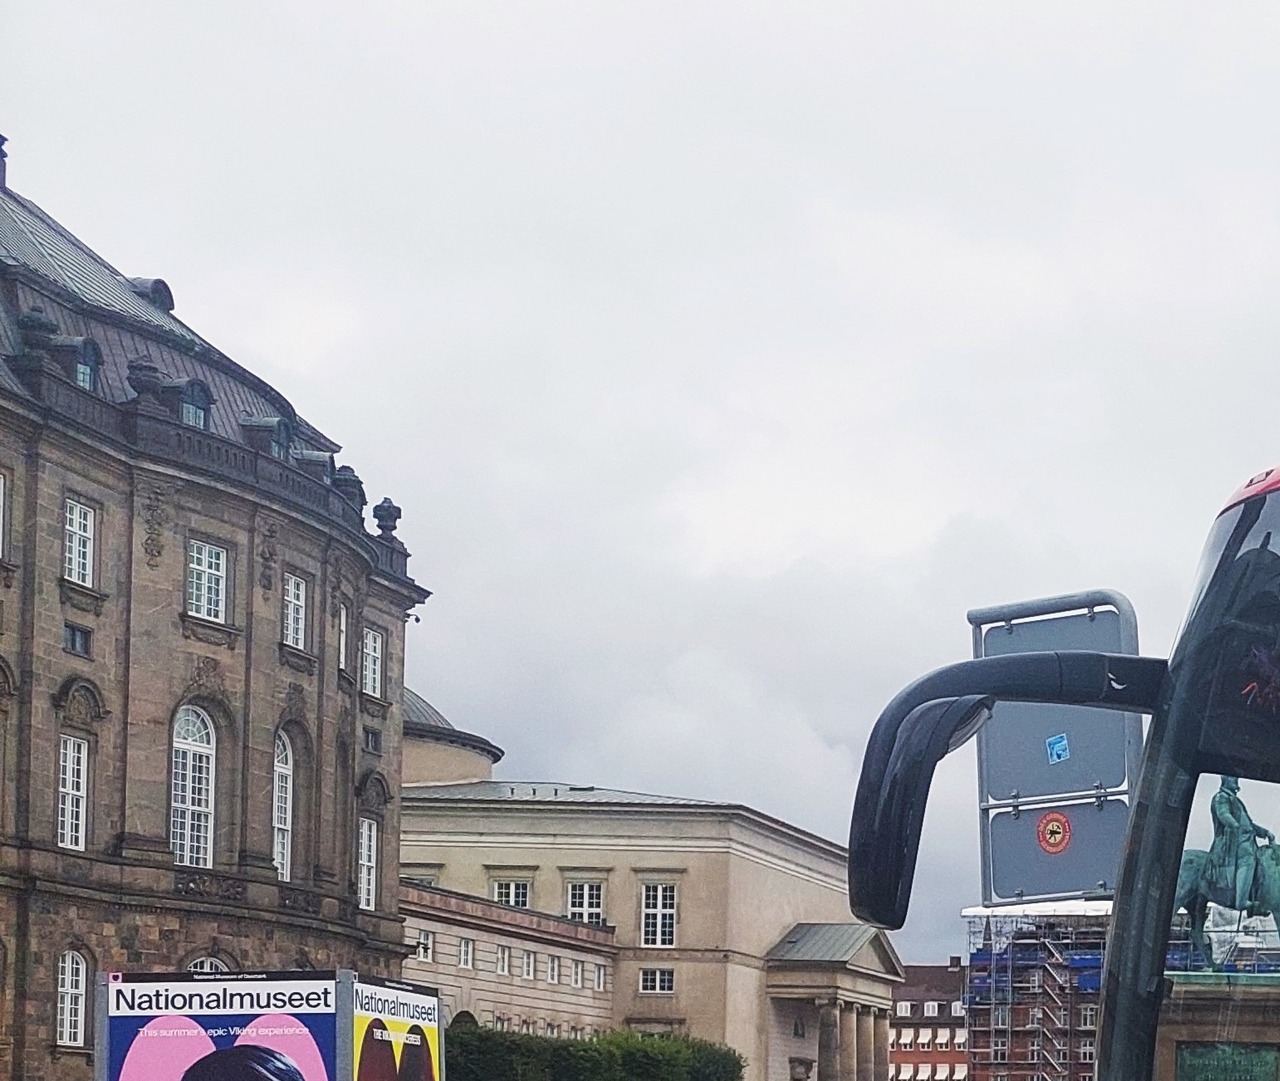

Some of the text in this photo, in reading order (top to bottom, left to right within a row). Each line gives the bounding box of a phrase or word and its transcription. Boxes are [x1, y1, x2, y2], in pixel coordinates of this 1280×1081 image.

[115, 988, 331, 1011] Nationalmuseet
[355, 988, 437, 1022] Nationalmuseet
[138, 1026, 310, 1038] This summer's epic Viking experience
